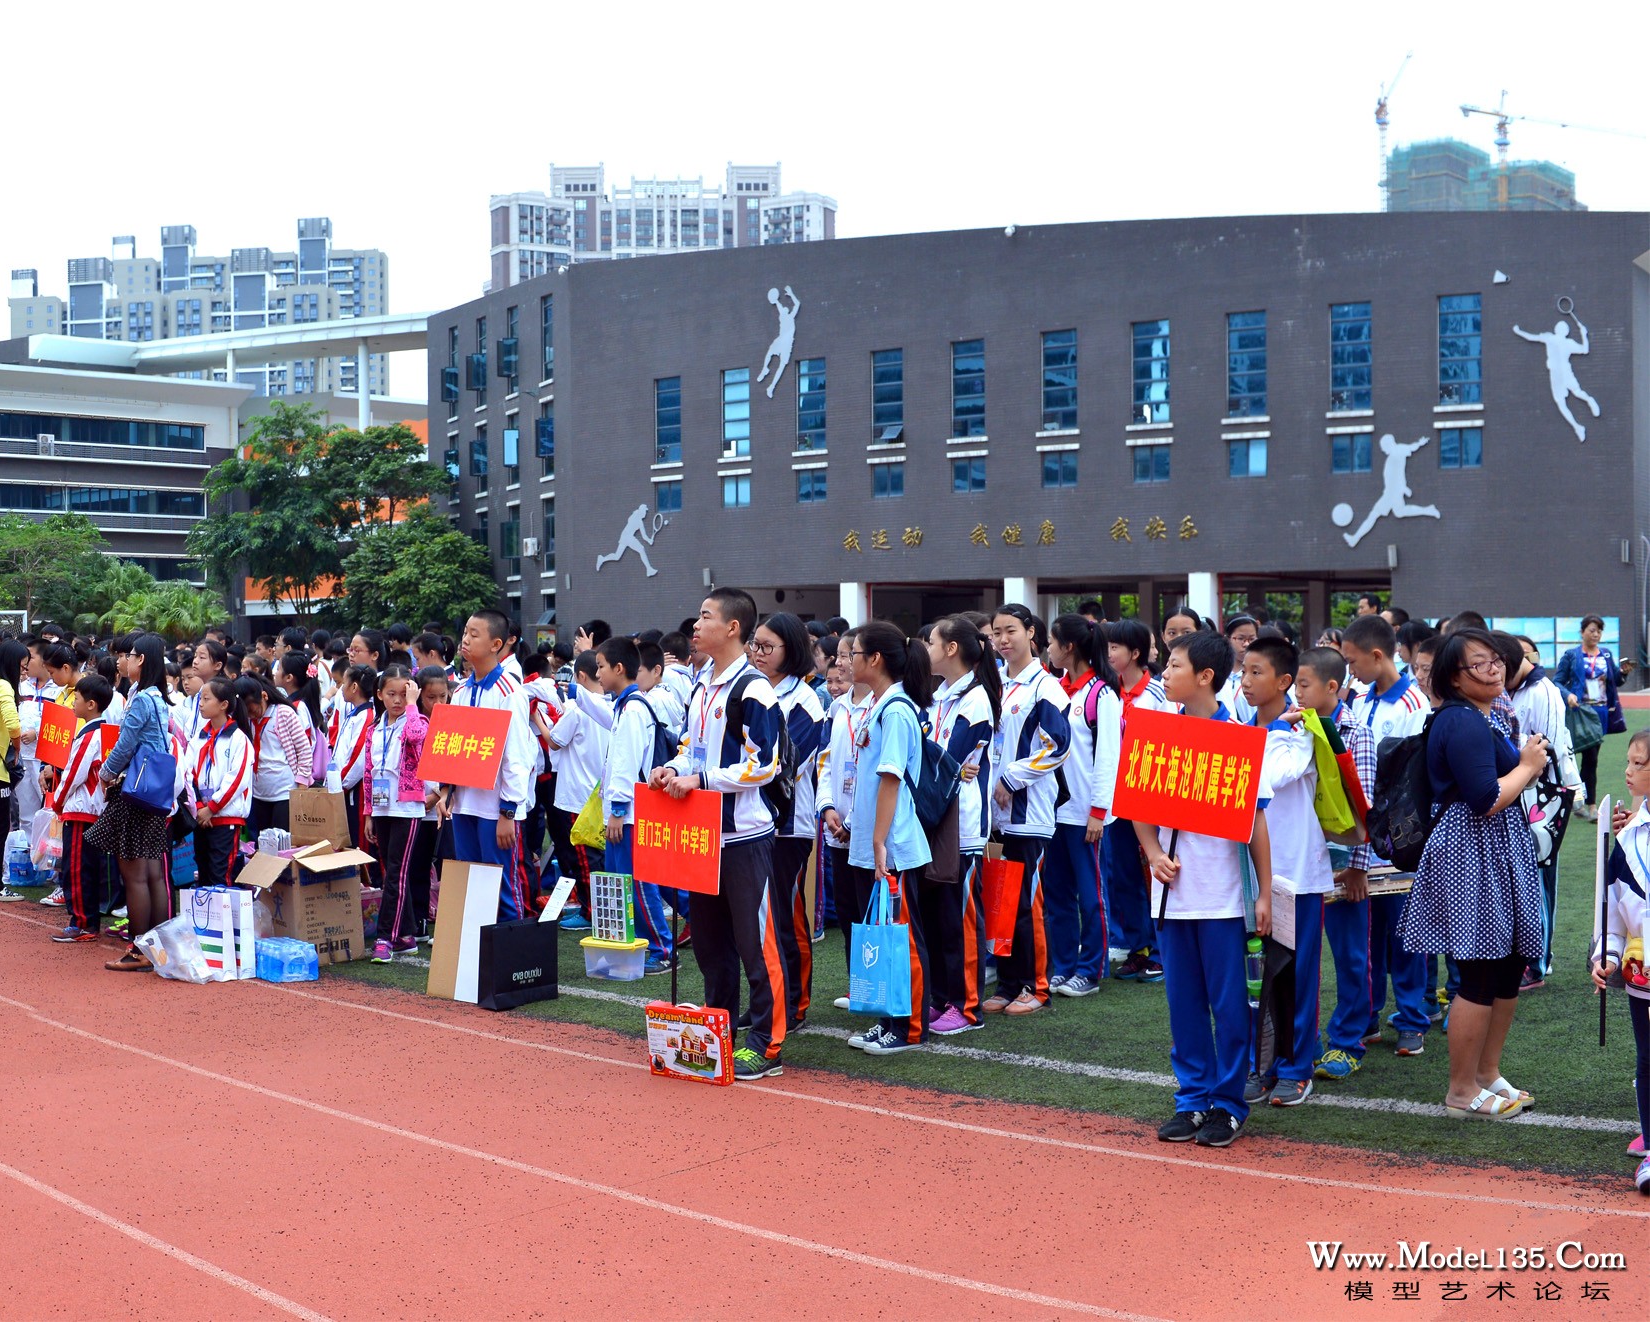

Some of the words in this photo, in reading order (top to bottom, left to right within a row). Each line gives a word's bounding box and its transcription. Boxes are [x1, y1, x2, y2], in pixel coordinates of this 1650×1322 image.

[843, 525, 925, 551] 我运动
[969, 518, 1056, 549] 我健康
[1109, 514, 1199, 543] 我快乐
[42, 722, 70, 748] 公园小学
[432, 731, 495, 760] 槟榔中学
[1125, 738, 1252, 810] 北师大海沧附属学校
[648, 1010, 679, 1021] Dream
[681, 1013, 704, 1025] Land
